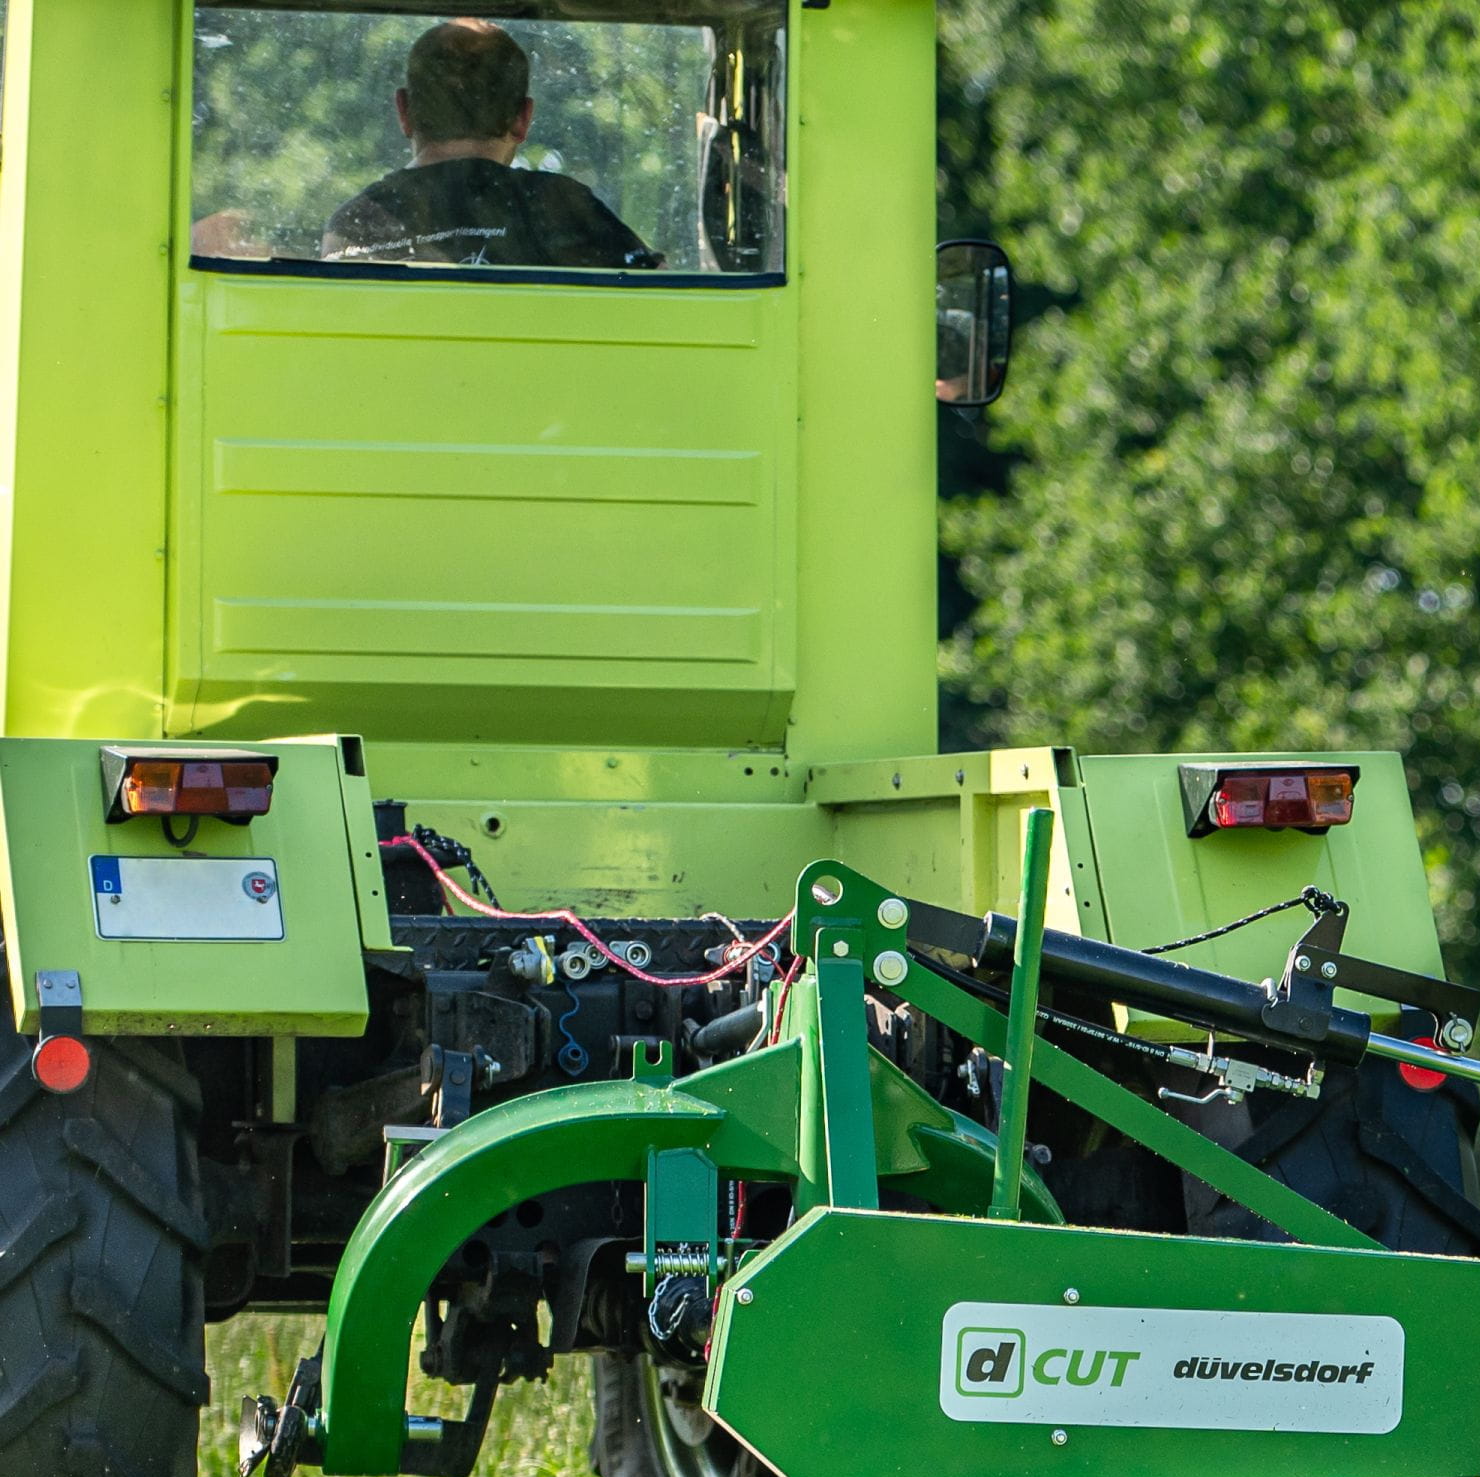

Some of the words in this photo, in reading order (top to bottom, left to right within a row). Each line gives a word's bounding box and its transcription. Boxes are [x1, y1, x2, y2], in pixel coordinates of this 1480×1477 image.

[103, 880, 113, 891] D
[966, 1342, 1016, 1383] d
[1032, 1348, 1141, 1387] CUT
[1173, 1356, 1375, 1384] düvelsdorf
